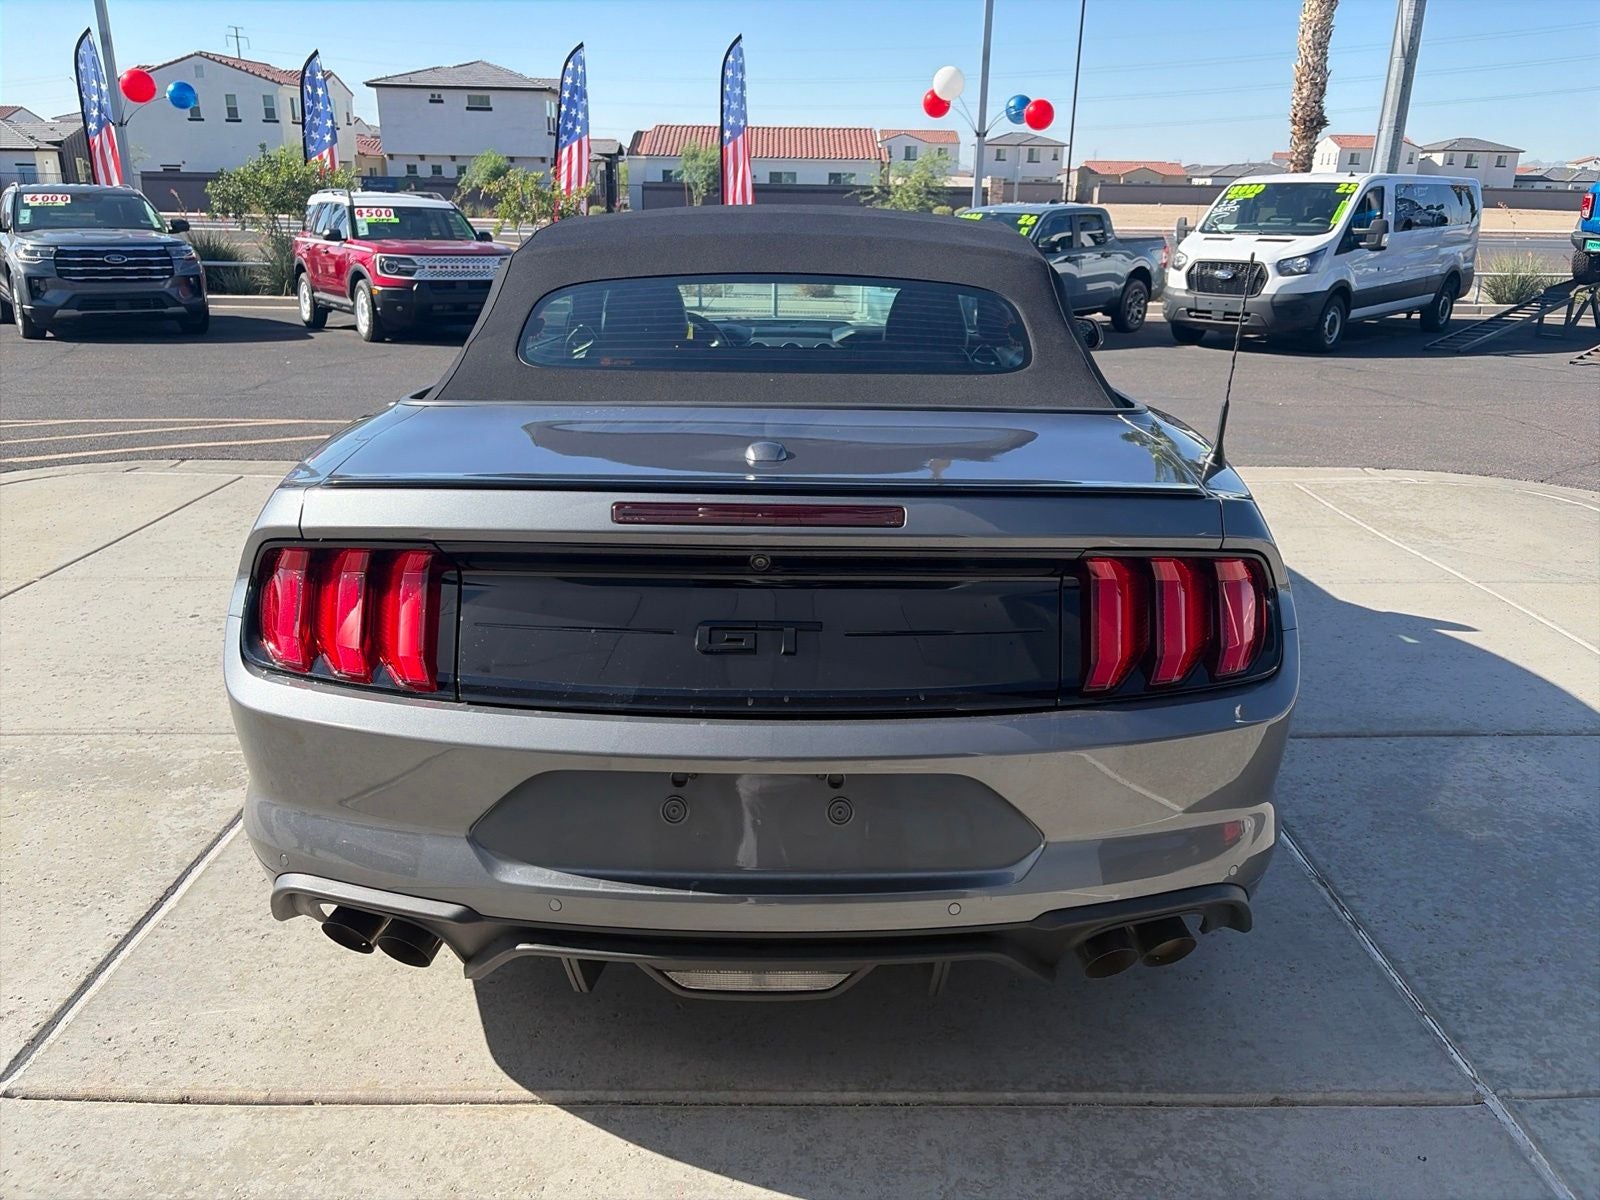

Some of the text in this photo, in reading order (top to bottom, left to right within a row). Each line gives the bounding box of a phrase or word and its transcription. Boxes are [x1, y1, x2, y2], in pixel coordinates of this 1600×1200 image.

[1335, 183, 1359, 194] 25
[1017, 214, 1038, 225] 26
[695, 620, 823, 656] GT
